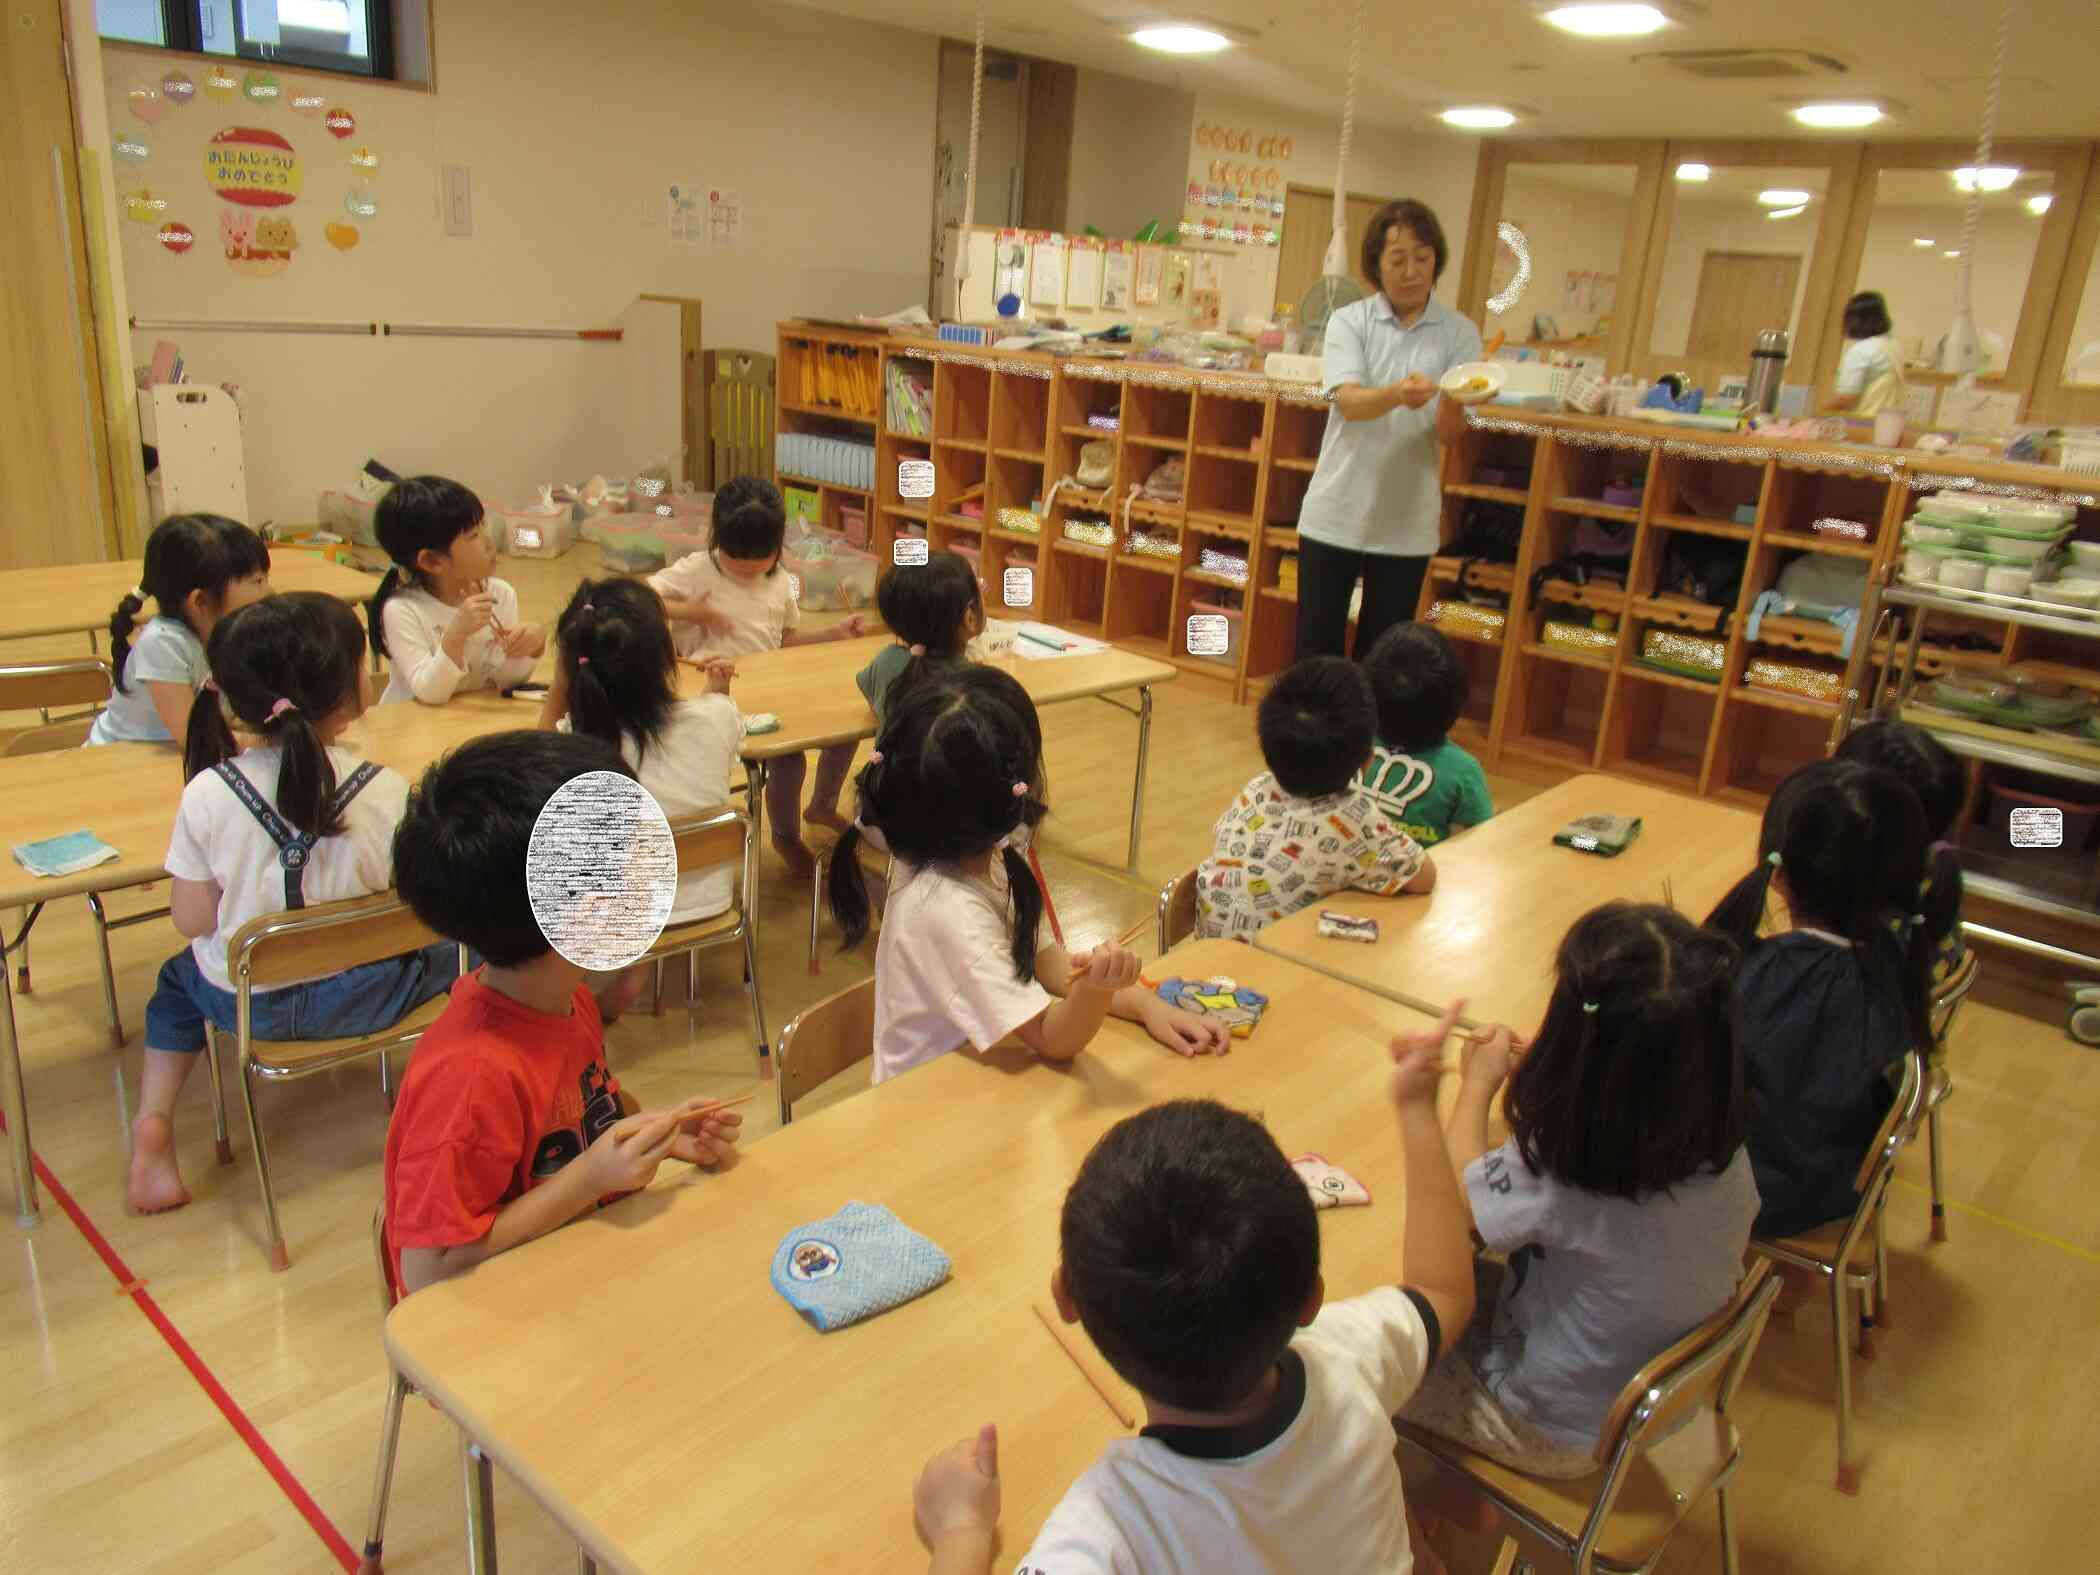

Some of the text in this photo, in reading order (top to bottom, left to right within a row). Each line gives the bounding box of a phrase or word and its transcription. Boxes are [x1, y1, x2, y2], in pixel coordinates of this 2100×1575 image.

[218, 166, 289, 185] おめでとう
